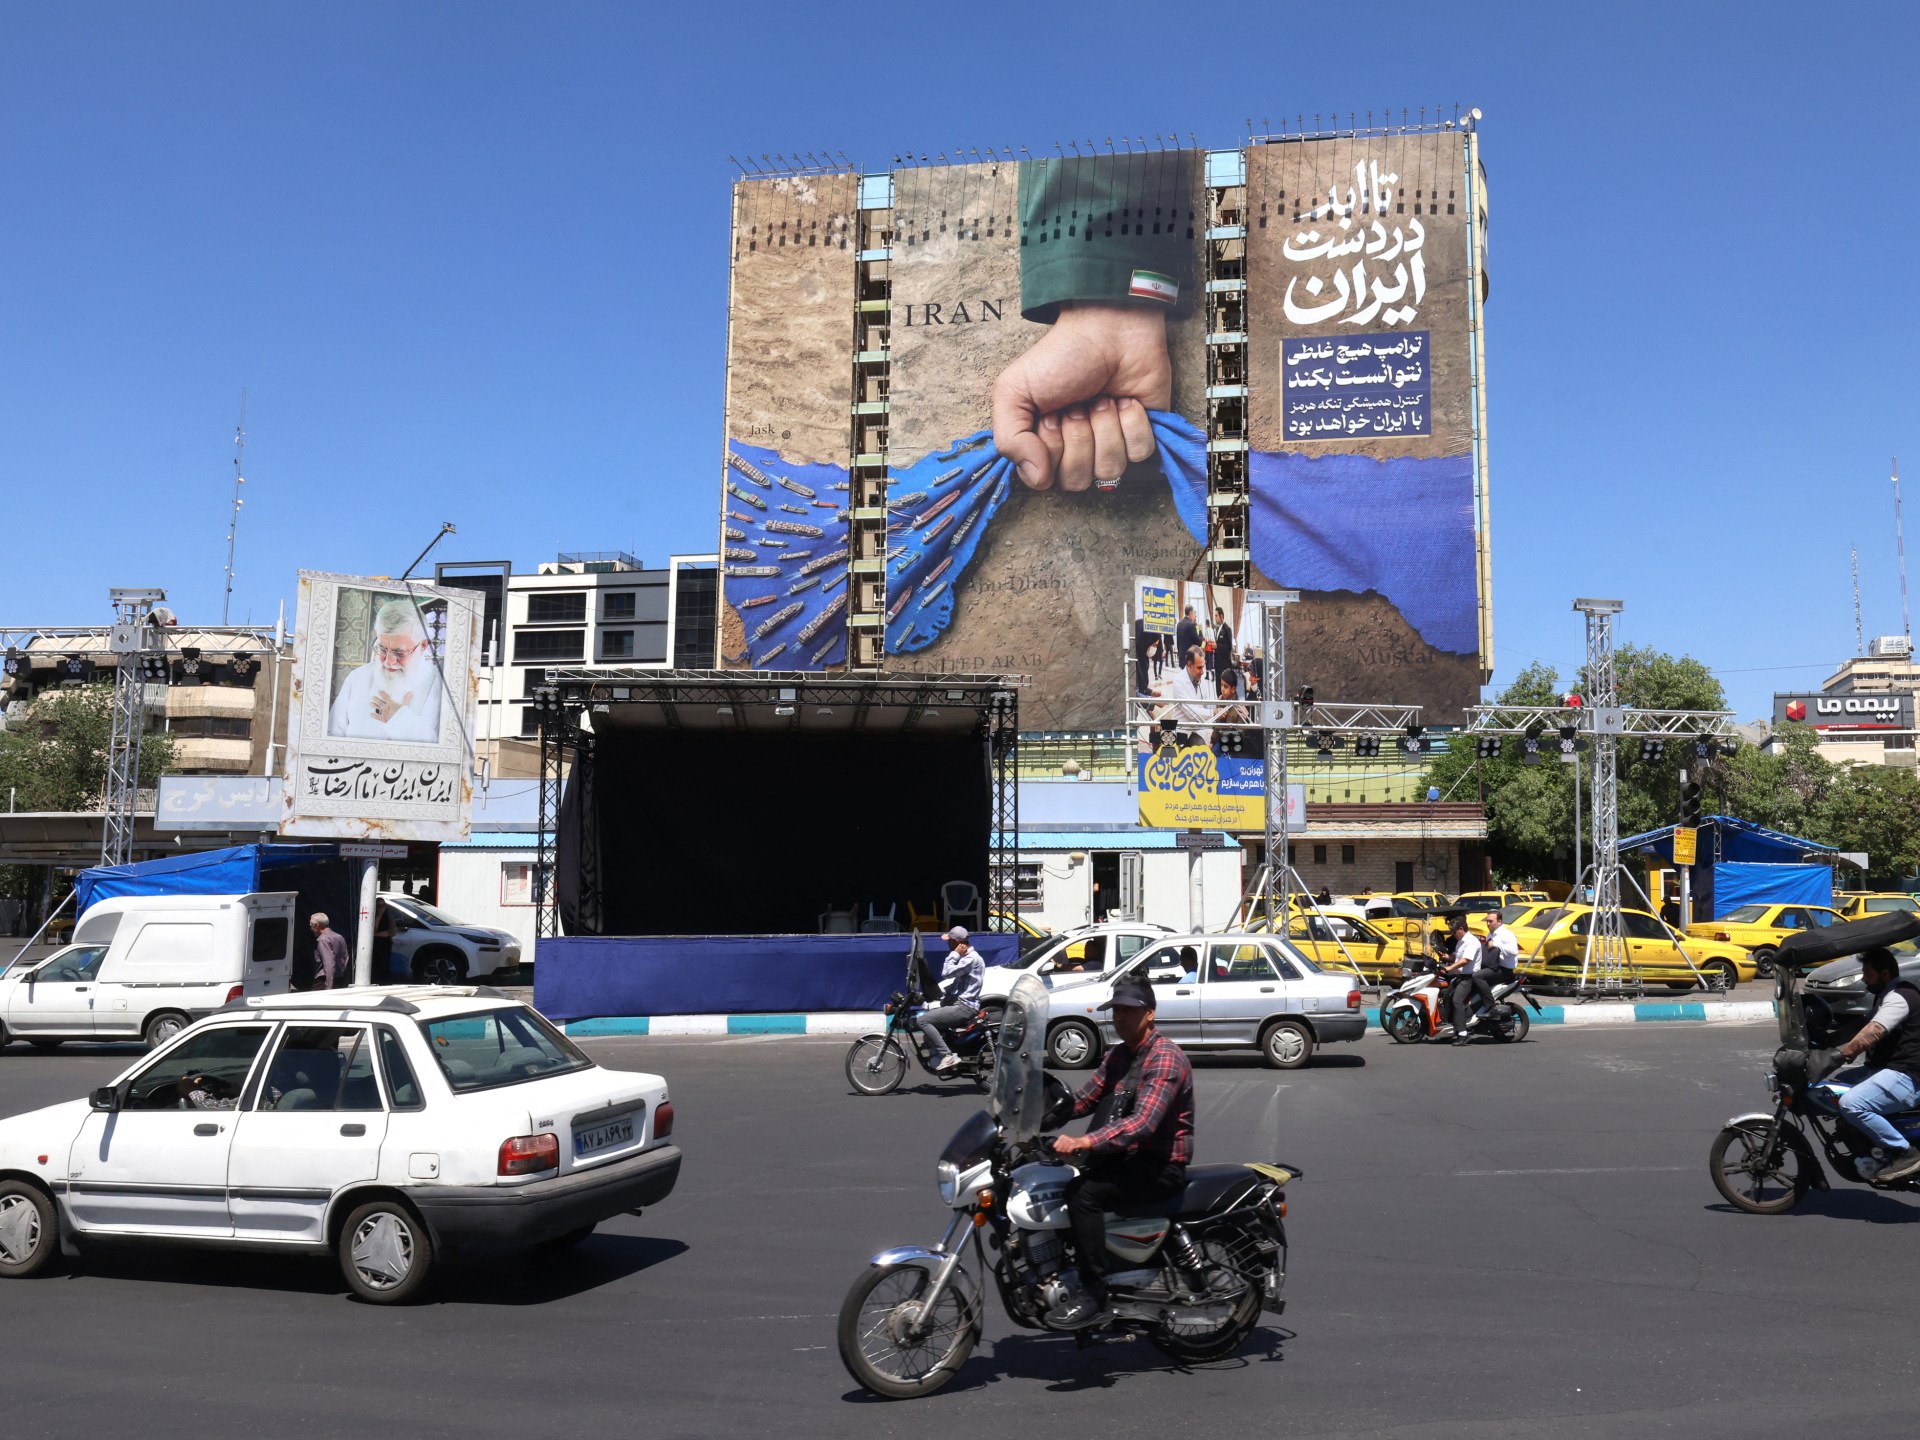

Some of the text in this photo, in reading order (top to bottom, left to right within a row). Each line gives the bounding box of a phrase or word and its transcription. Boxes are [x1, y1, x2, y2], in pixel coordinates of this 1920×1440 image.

[1289, 158, 1367, 230] ابد
[1283, 217, 1425, 261] در دست
[1283, 249, 1426, 326] ایران
[904, 298, 1004, 327] IRAN
[1287, 336, 1422, 366] ترامپ هیچ غلطی
[1288, 361, 1422, 391] نتوانست بکند
[1289, 394, 1424, 414] کنترل همیشگی تنگه هرمز
[748, 423, 775, 438] Jask
[1289, 410, 1423, 436] با ایران خواهد بود
[912, 653, 1042, 673] UNITED ARAB
[1816, 697, 1900, 719] بیمه ما
[1221, 778, 1239, 789] سازیم
[1247, 765, 1264, 777] تهران
[163, 780, 218, 812] کرج
[1240, 780, 1248, 790] می
[1249, 780, 1259, 789] هم
[583, 1133, 594, 1150] ۸۷
[605, 1124, 622, 1143] ۸۶۹
